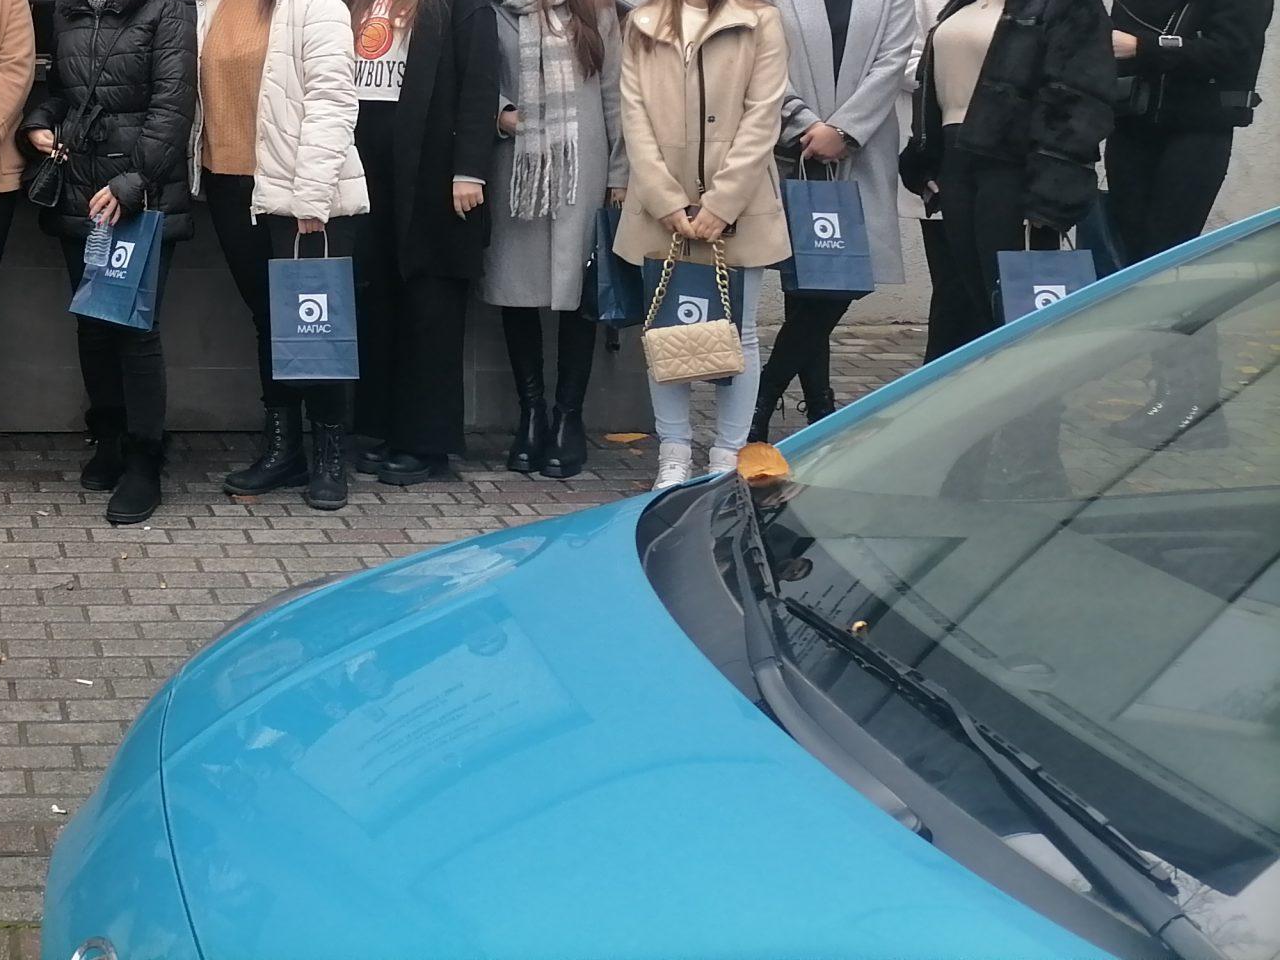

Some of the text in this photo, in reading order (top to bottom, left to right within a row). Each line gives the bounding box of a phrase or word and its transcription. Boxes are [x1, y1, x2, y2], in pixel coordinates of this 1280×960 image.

[354, 60, 407, 87] WBOYS
[814, 240, 846, 250] МАПАС
[104, 269, 129, 280] МАПАС
[297, 323, 332, 334] МАПАС
